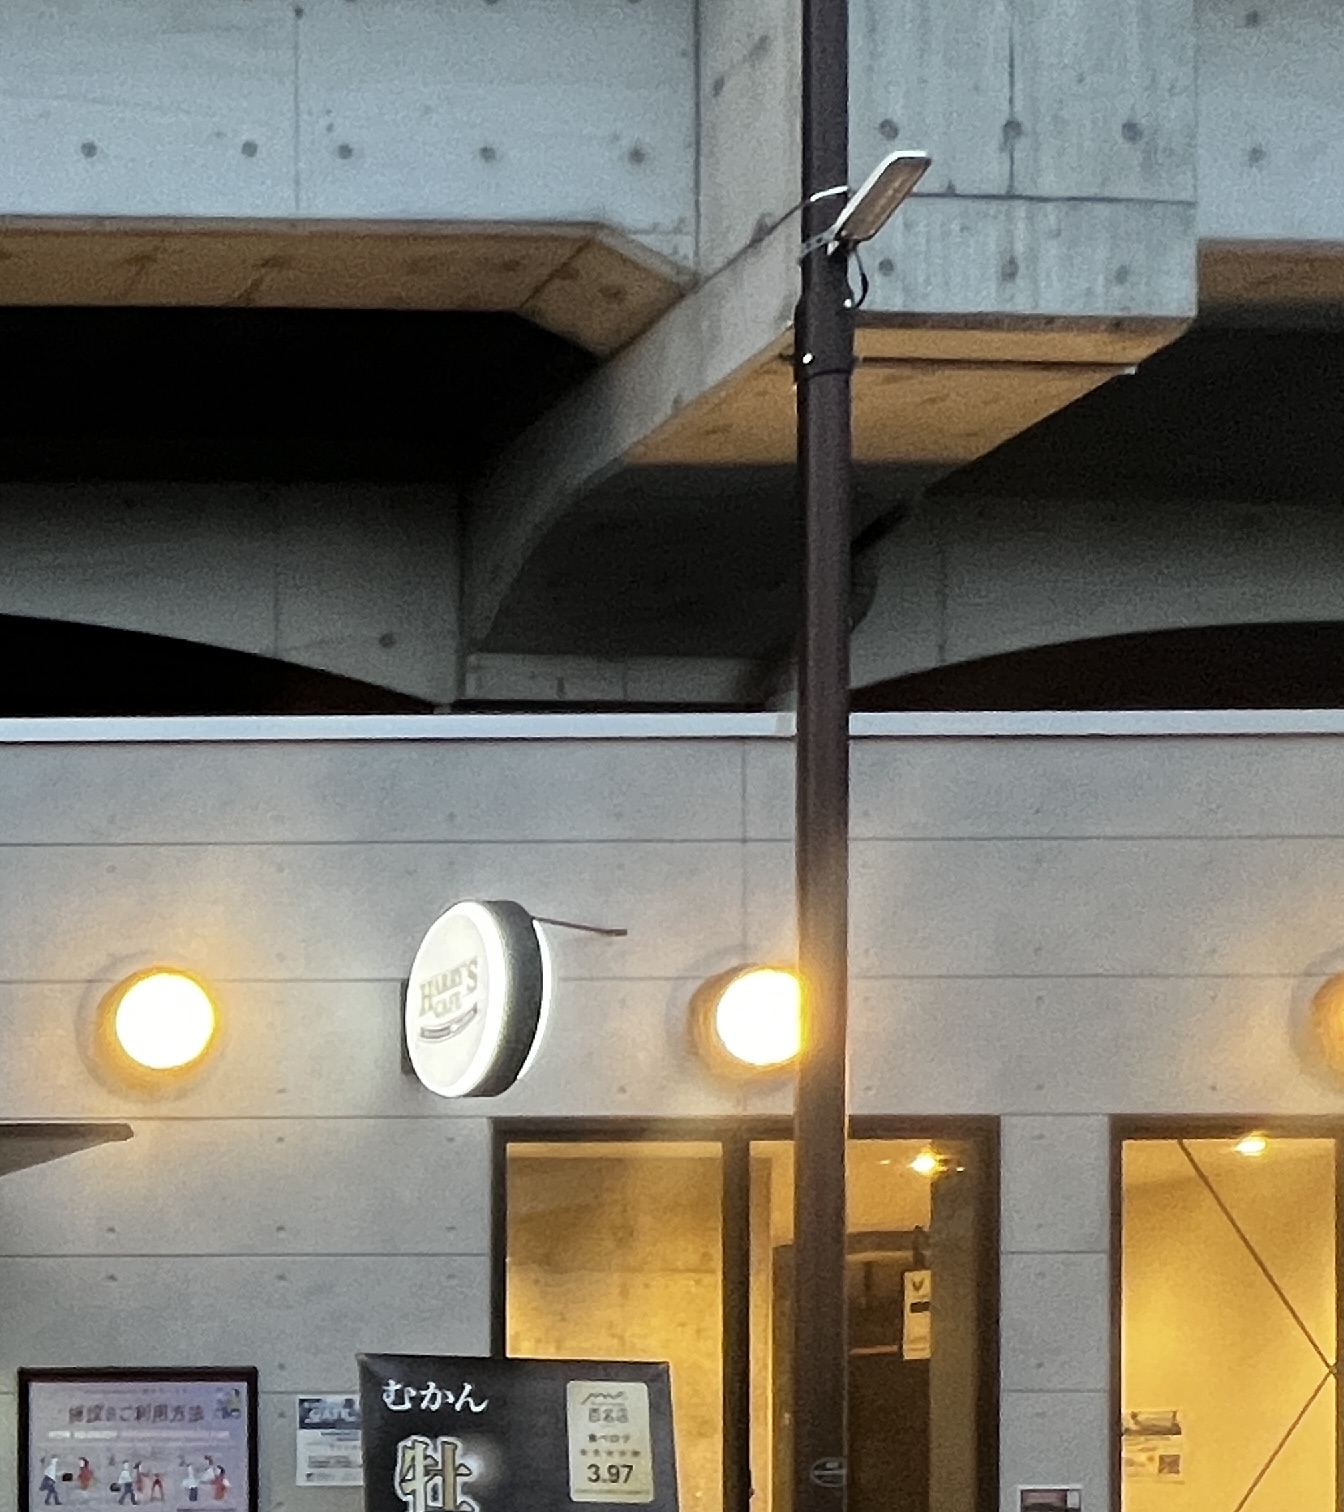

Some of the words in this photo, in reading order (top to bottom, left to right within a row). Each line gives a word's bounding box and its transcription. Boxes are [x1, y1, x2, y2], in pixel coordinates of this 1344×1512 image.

[382, 1378, 489, 1412] むかん
[587, 1463, 634, 1484] 3.97
